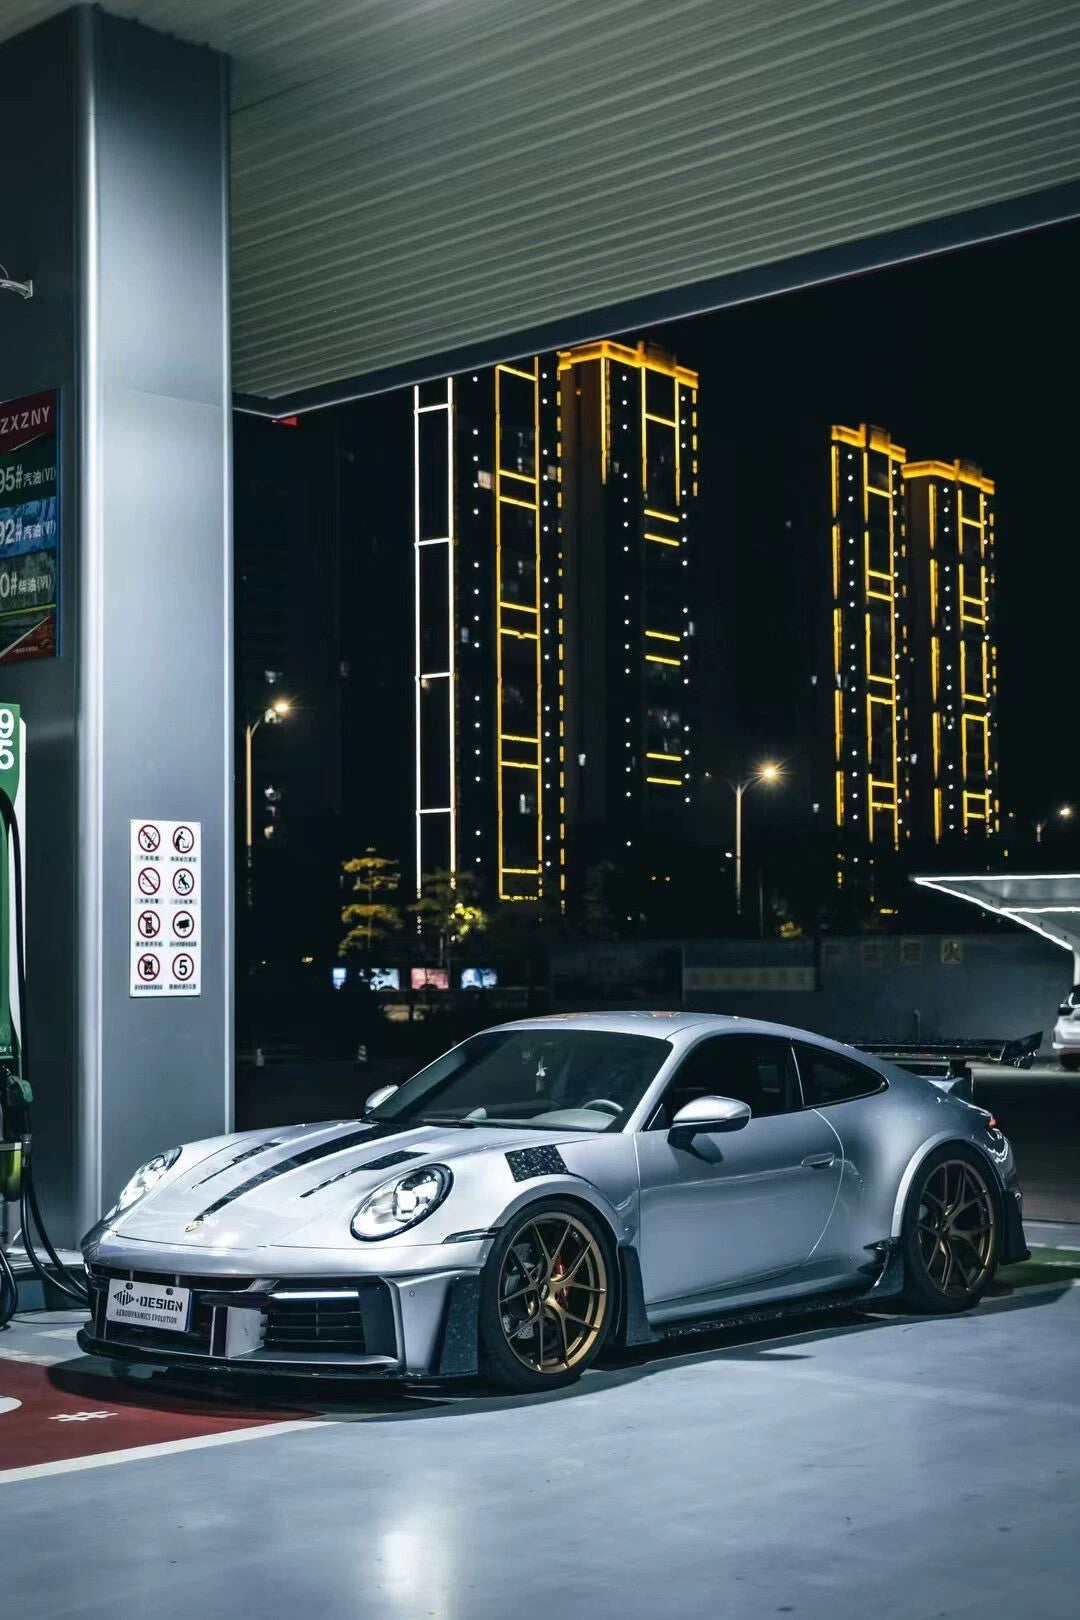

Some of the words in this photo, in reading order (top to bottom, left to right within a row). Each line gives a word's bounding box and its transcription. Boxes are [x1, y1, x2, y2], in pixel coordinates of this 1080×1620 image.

[0, 406, 50, 434] ZXZNY
[178, 959, 188, 976] 5
[151, 1314, 177, 1324] EVOLUTION
